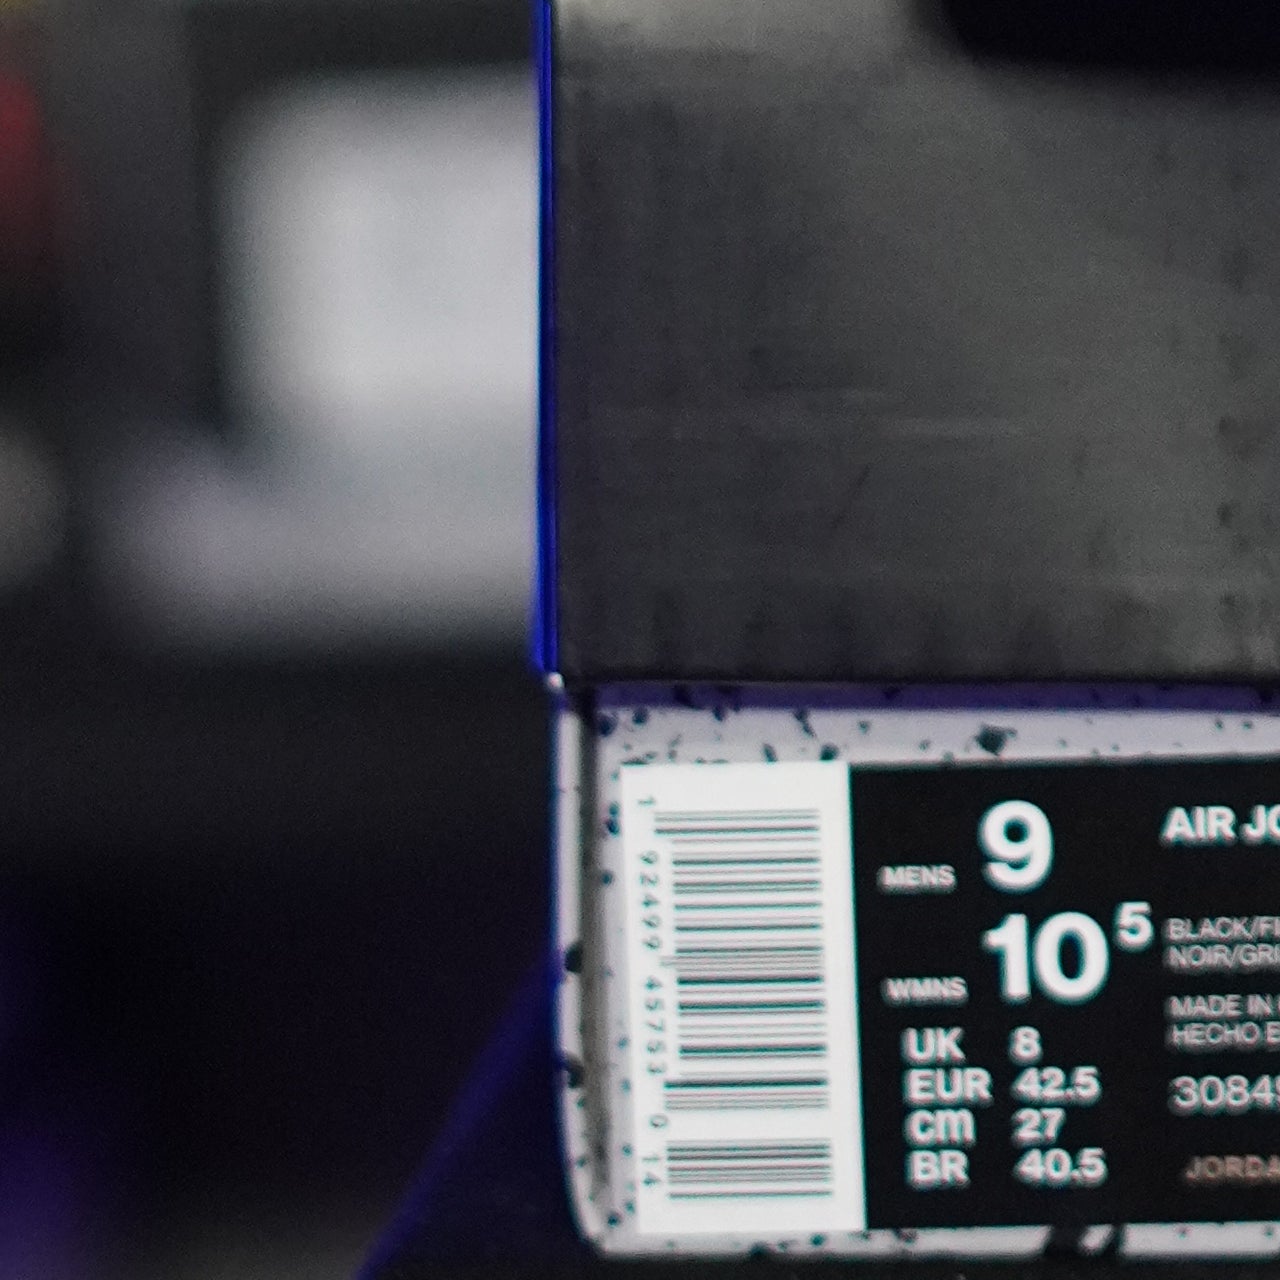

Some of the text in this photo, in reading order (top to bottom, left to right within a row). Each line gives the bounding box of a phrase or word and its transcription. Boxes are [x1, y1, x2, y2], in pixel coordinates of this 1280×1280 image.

[1160, 805, 1238, 842] AIR
[879, 800, 1054, 892] MENS 9
[881, 976, 968, 1005] WMNS
[1167, 994, 1243, 1020] MADE
[1247, 993, 1273, 1018] IN
[902, 1025, 1043, 1065] UK 8
[1167, 1020, 1261, 1049] HECHO
[904, 1065, 1102, 1106] EUR 42.5
[905, 1107, 1066, 1146] cm 27
[907, 1146, 1108, 1188] BR 40.5
